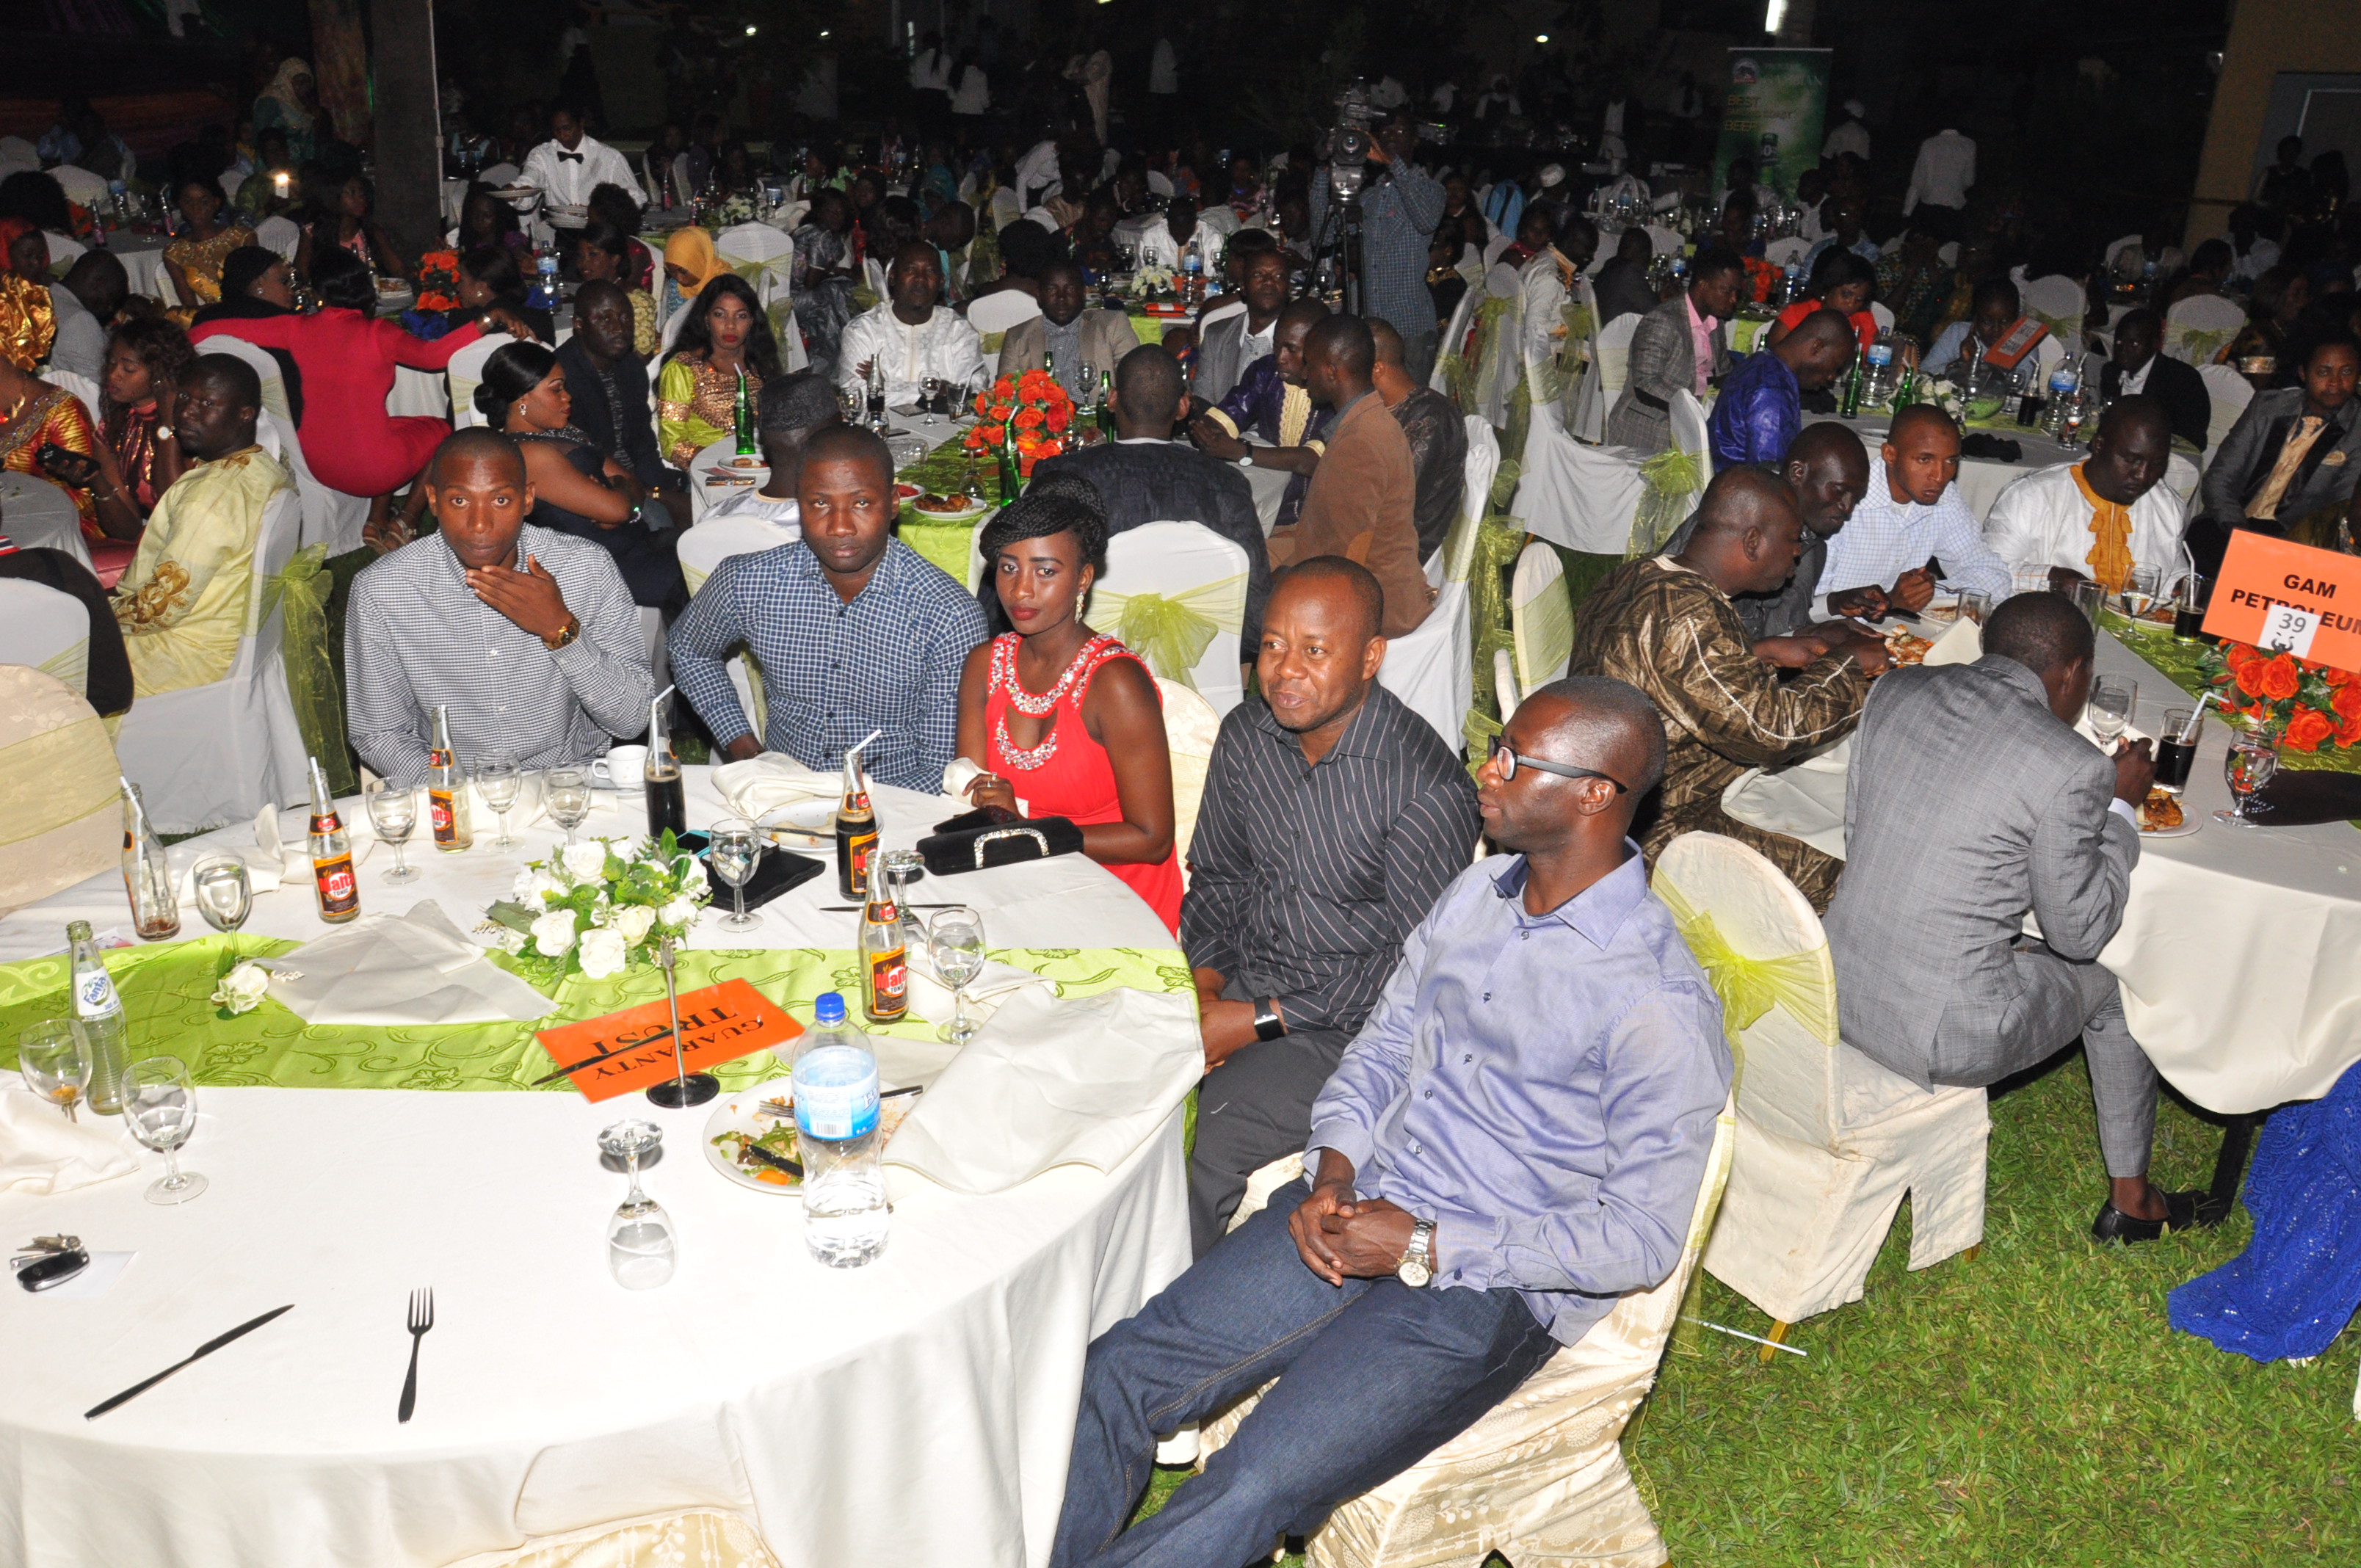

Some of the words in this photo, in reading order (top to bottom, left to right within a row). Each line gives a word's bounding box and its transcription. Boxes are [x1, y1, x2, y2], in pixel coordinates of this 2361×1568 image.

[1727, 95, 1761, 108] BEST
[2283, 574, 2337, 598] GAM
[2279, 613, 2307, 633] 39
[83, 976, 106, 1004] Fanta
[595, 1020, 764, 1080] GUARANTY
